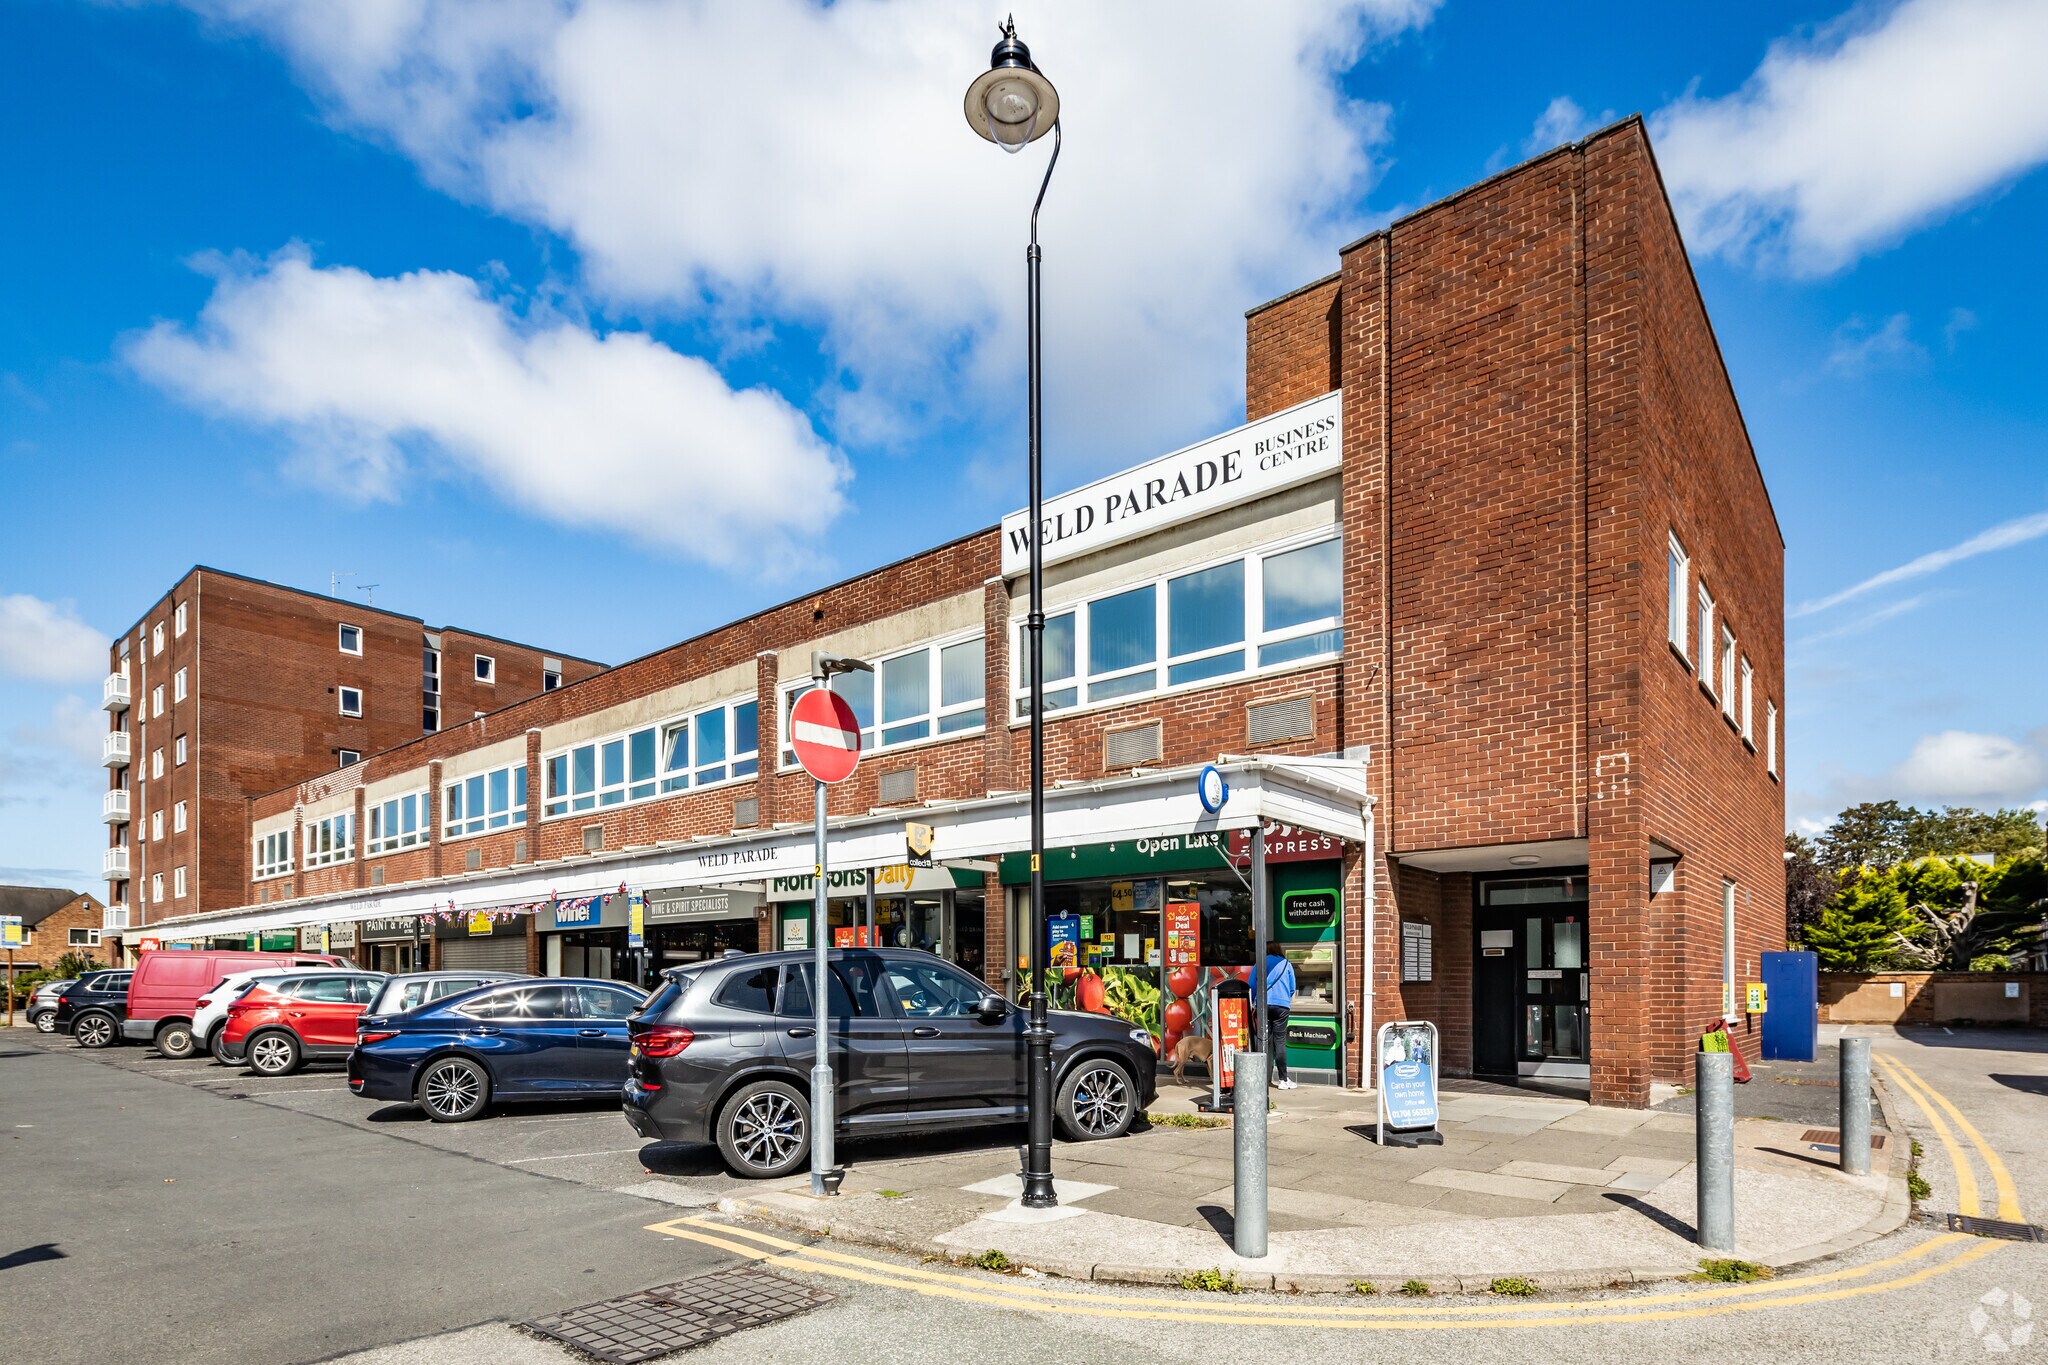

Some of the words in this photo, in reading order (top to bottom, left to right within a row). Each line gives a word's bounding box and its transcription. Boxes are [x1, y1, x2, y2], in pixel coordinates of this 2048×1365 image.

[1254, 415, 1336, 457] BUSINESS
[1259, 435, 1330, 472] CENTRE
[1008, 504, 1095, 556] WELD
[1104, 450, 1243, 526] PARADE
[1136, 837, 1179, 857] Open
[1185, 834, 1219, 849] Late
[1264, 838, 1332, 856] XPRESS
[698, 853, 728, 867] WELD
[733, 847, 778, 864] PARADE
[1031, 855, 1037, 869] 1
[774, 868, 866, 892] Morrons
[874, 864, 915, 890] aily
[815, 865, 821, 877] 2
[651, 902, 665, 915] WINE
[666, 902, 671, 913] &
[671, 900, 690, 914] SPIRIT
[691, 897, 729, 912] SPECIALISTS
[1288, 908, 1329, 917] withdrawals
[1293, 900, 1307, 908] free
[1308, 899, 1325, 907] cash
[366, 920, 388, 932] PAINT
[1412, 1081, 1426, 1089] your
